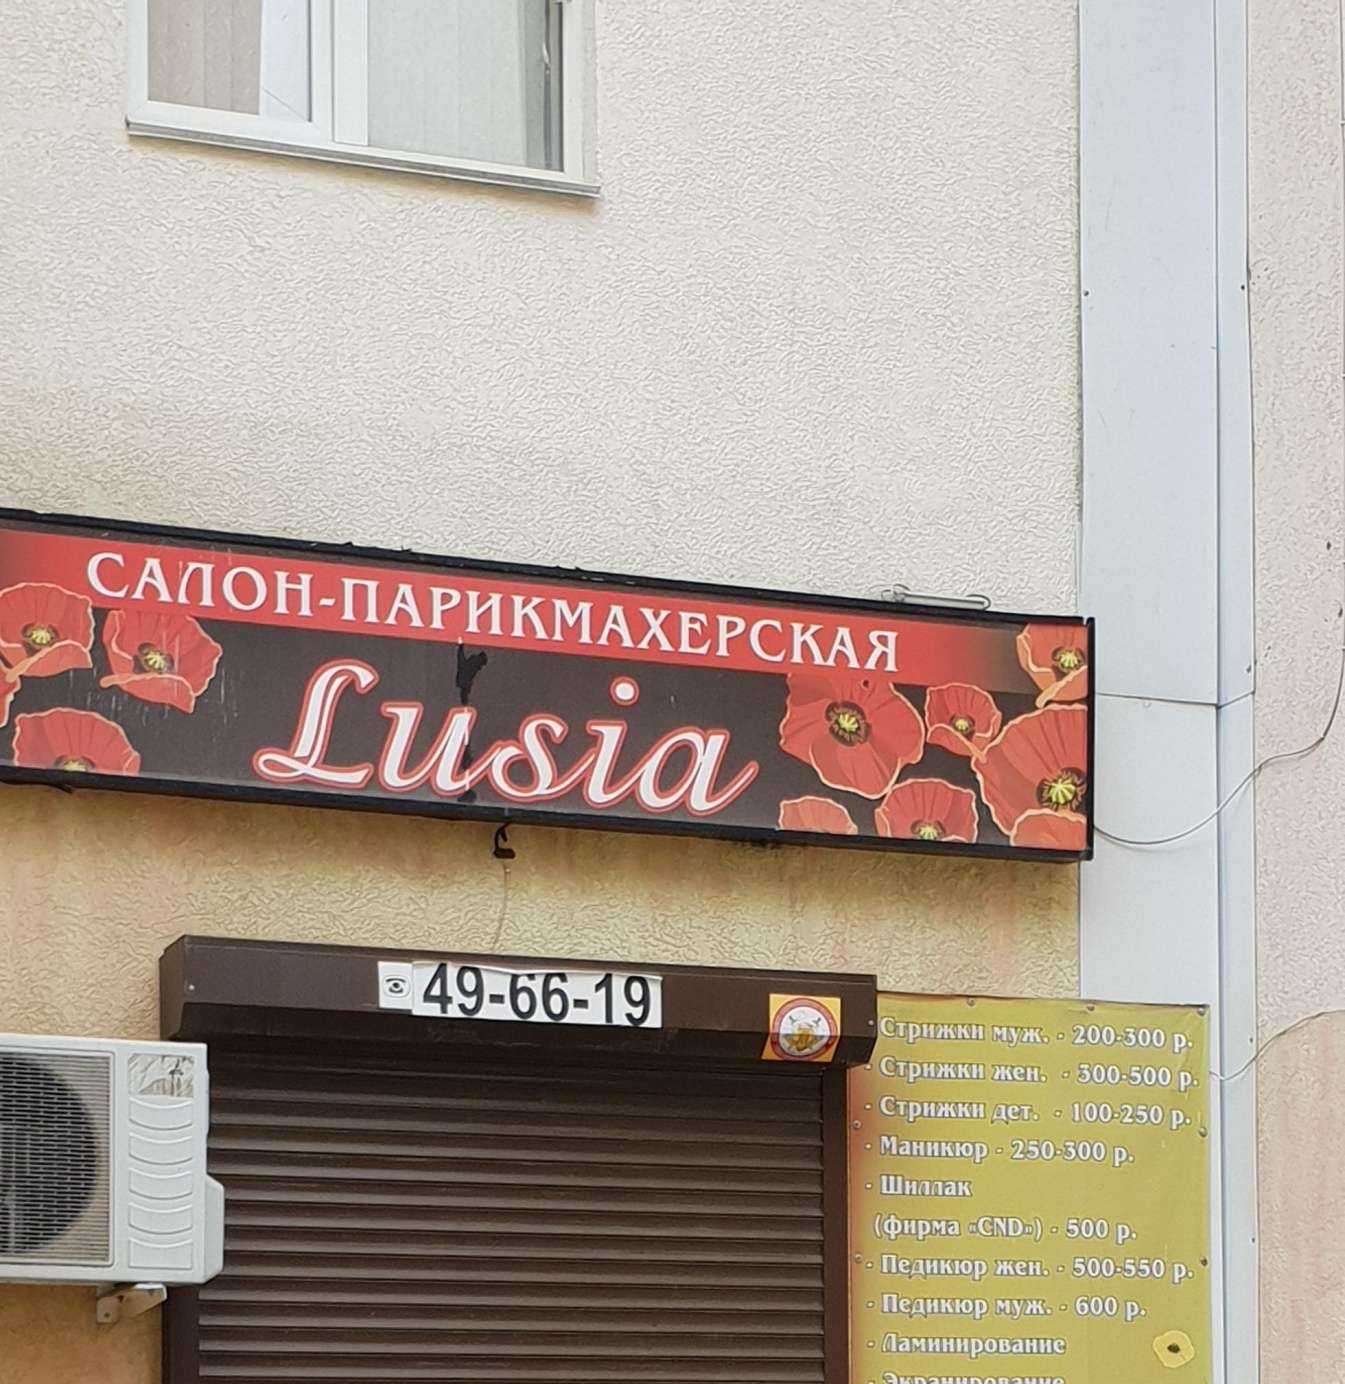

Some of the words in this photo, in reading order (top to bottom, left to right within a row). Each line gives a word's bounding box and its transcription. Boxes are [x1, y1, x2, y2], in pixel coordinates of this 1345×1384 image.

[87, 552, 900, 674] САЛОН-ПАРИКМАХЕРСКАЯ
[253, 658, 760, 818] Lusia
[422, 963, 652, 1026] 49-66-19
[879, 1017, 985, 1047] Стрижки
[992, 1024, 1049, 1048] муж.
[1072, 1025, 1166, 1049] 200-300
[1172, 1033, 1193, 1054] р.
[879, 1057, 986, 1083] Стрижки
[992, 1063, 1048, 1083] жен.
[1077, 1064, 1172, 1087] 300-500
[1178, 1070, 1198, 1092] р.
[879, 1096, 986, 1123] Стрижки
[991, 1104, 1039, 1126] дет.
[1072, 1103, 1163, 1125] 100-250
[1170, 1110, 1192, 1130] р.
[880, 1135, 988, 1163] Маникюр
[1011, 1140, 1106, 1162] 250-300
[1113, 1147, 1135, 1168] р.
[880, 1174, 972, 1198] Шиллак
[873, 1214, 961, 1240] (фирма
[1065, 1219, 1109, 1240] 500
[1116, 1222, 1137, 1245] р.
[880, 1254, 988, 1281] Педикюр
[995, 1260, 1049, 1276] жен.
[1072, 1257, 1166, 1279] 500-550
[1172, 1264, 1194, 1284] р.
[881, 1294, 988, 1319] Педикюр
[995, 1300, 1052, 1320] муж.
[1075, 1296, 1118, 1316] 600
[1124, 1299, 1147, 1322] р.
[881, 1333, 1066, 1359] Ламинирование
